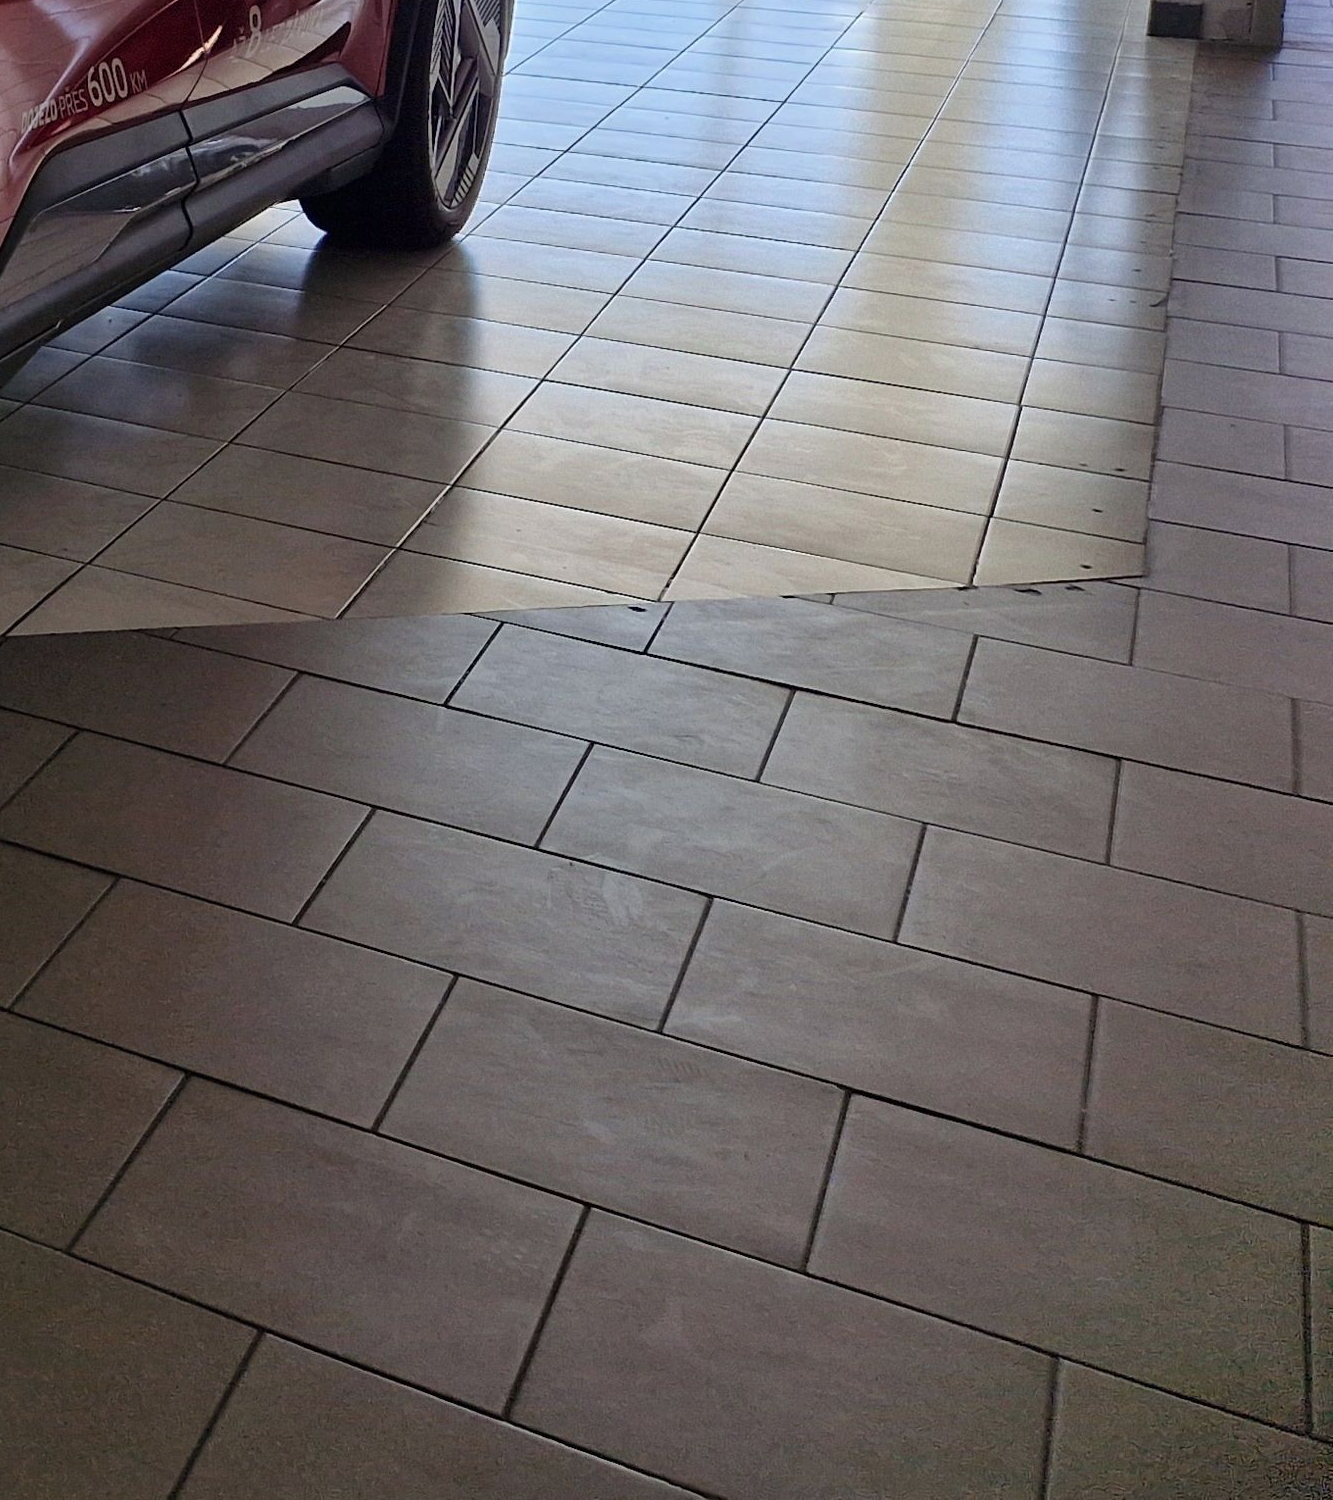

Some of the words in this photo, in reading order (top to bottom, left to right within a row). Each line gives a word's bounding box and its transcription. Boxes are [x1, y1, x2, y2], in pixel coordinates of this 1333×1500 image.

[58, 86, 89, 119] PŘES
[87, 57, 129, 107] 600
[129, 69, 149, 94] KM
